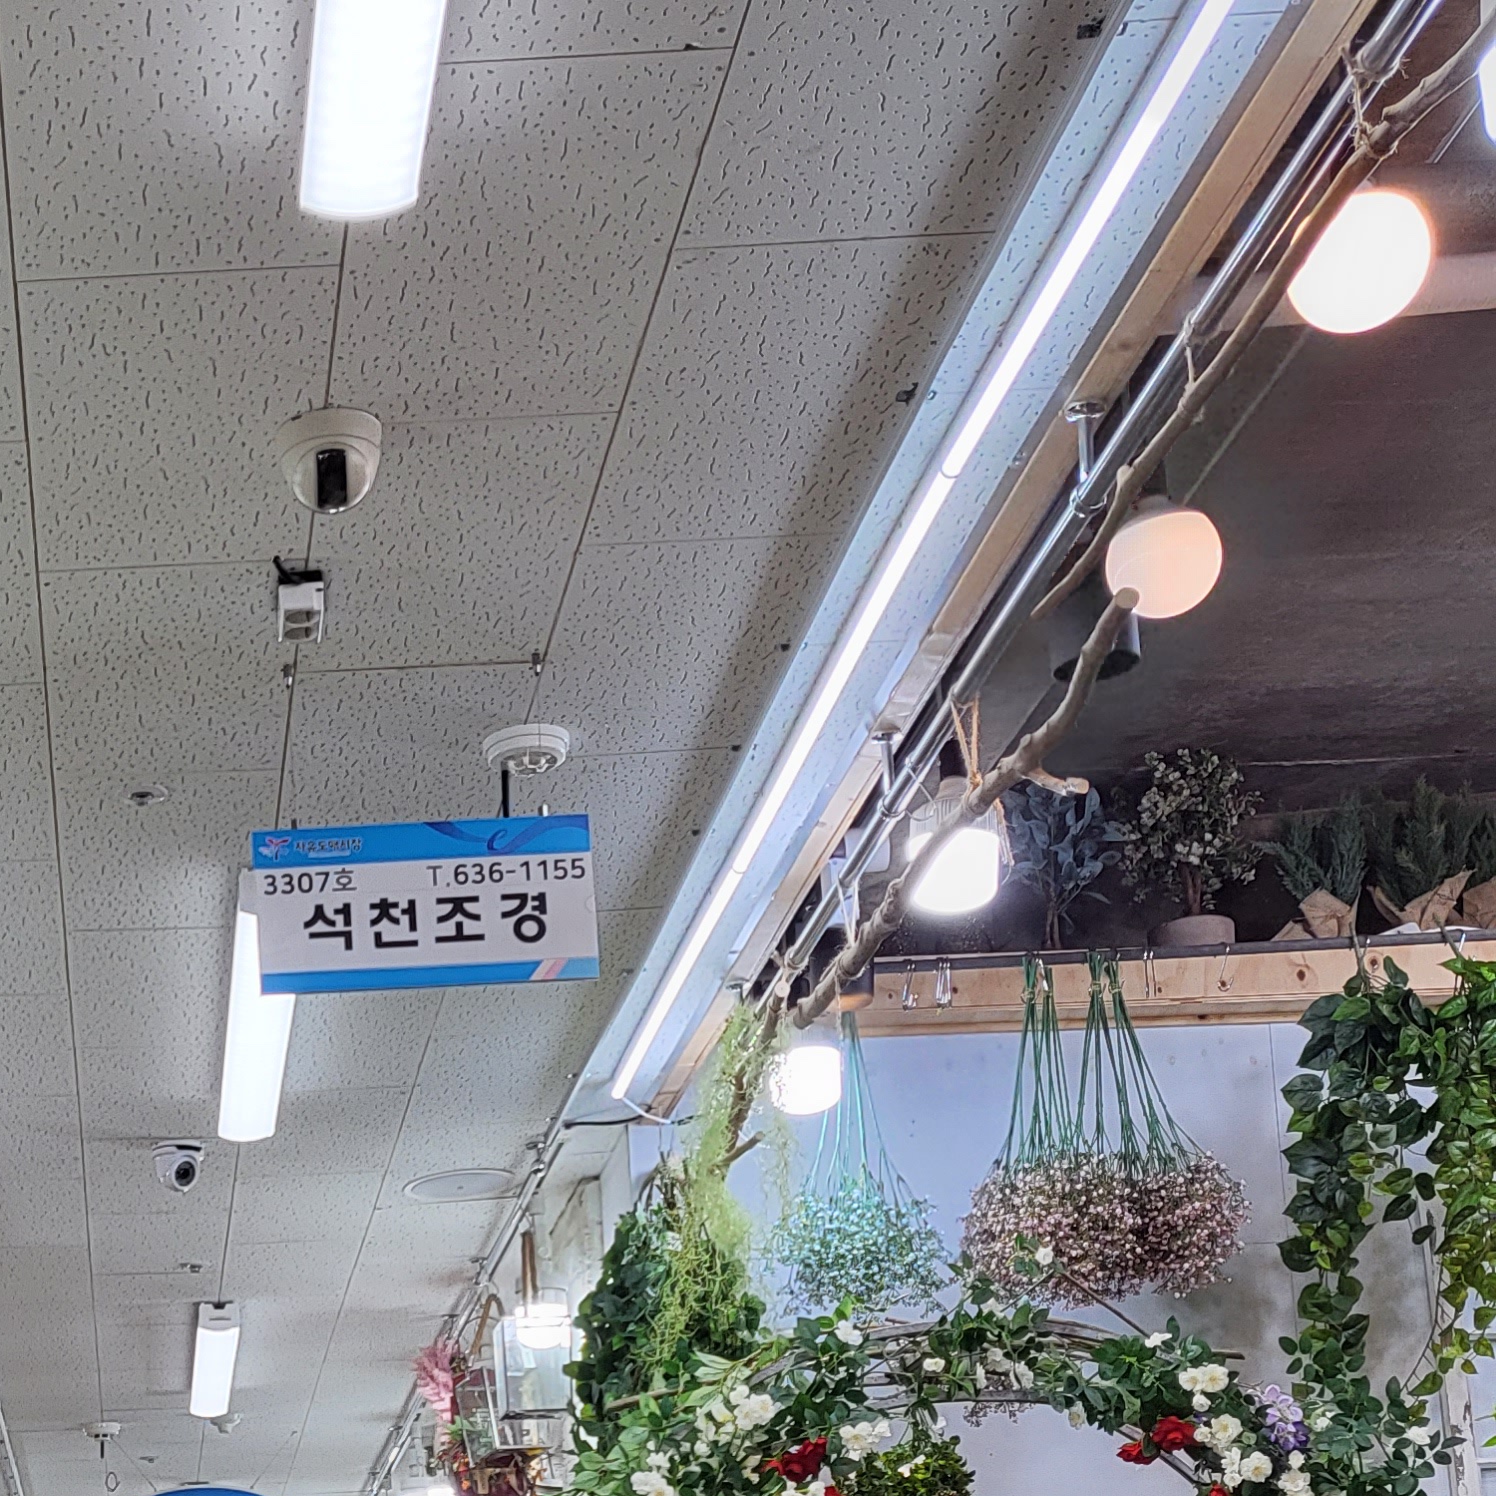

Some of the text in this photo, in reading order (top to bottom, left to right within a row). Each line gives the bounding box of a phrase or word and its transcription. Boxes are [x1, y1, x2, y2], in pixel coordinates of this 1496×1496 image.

[263, 858, 587, 895] 3307호 T.636-1155
[303, 891, 549, 951] 석천조경
